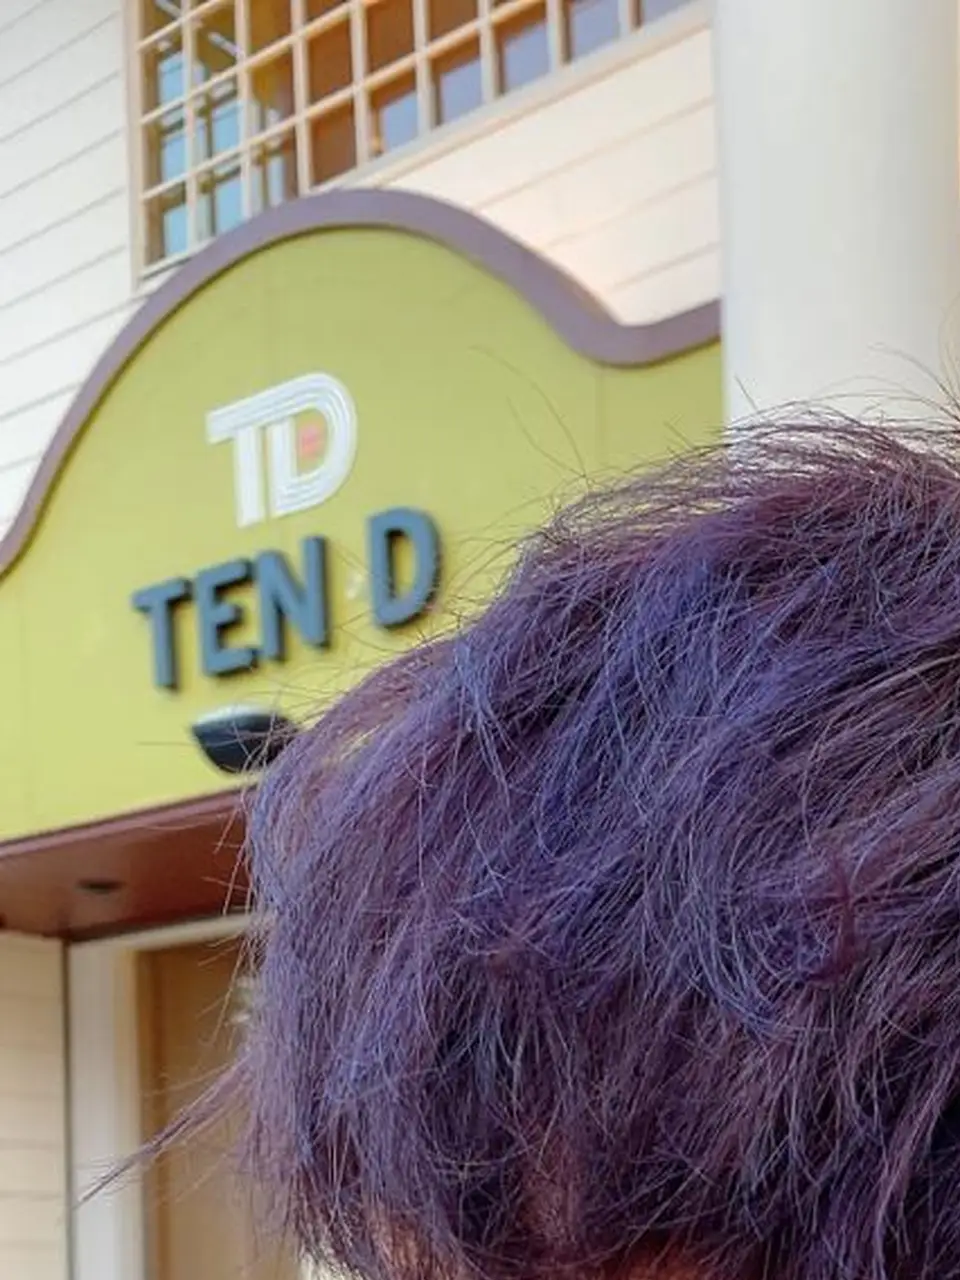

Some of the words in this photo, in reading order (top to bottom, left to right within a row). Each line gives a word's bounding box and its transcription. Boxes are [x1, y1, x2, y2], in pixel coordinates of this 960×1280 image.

[207, 372, 358, 528] TD
[131, 535, 329, 690] TEN
[366, 507, 444, 630] D
